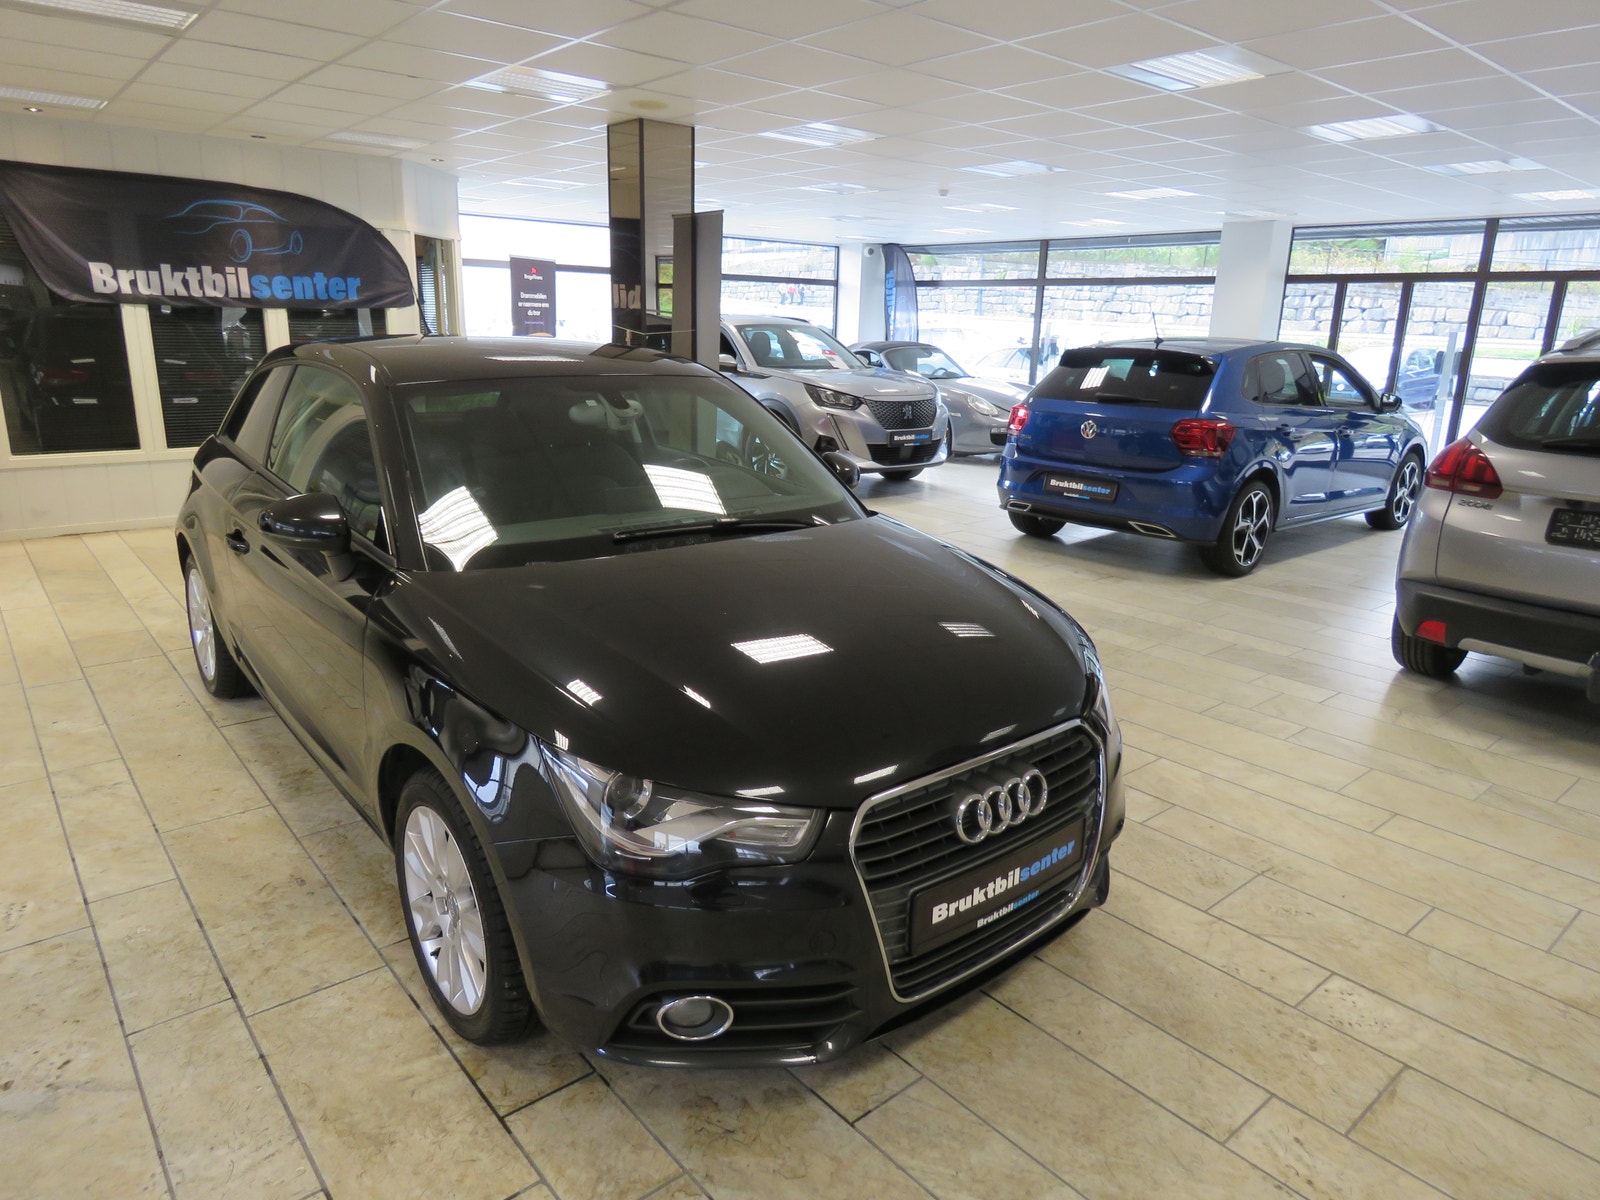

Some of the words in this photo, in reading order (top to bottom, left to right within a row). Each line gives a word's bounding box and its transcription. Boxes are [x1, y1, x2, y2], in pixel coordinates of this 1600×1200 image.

[87, 261, 361, 301] Bruktbilsenter
[1050, 479, 1111, 495] Bruktbilsenter
[931, 839, 1076, 925] Bruktbilsenter
[976, 889, 1040, 929] Bruktbilsenter
